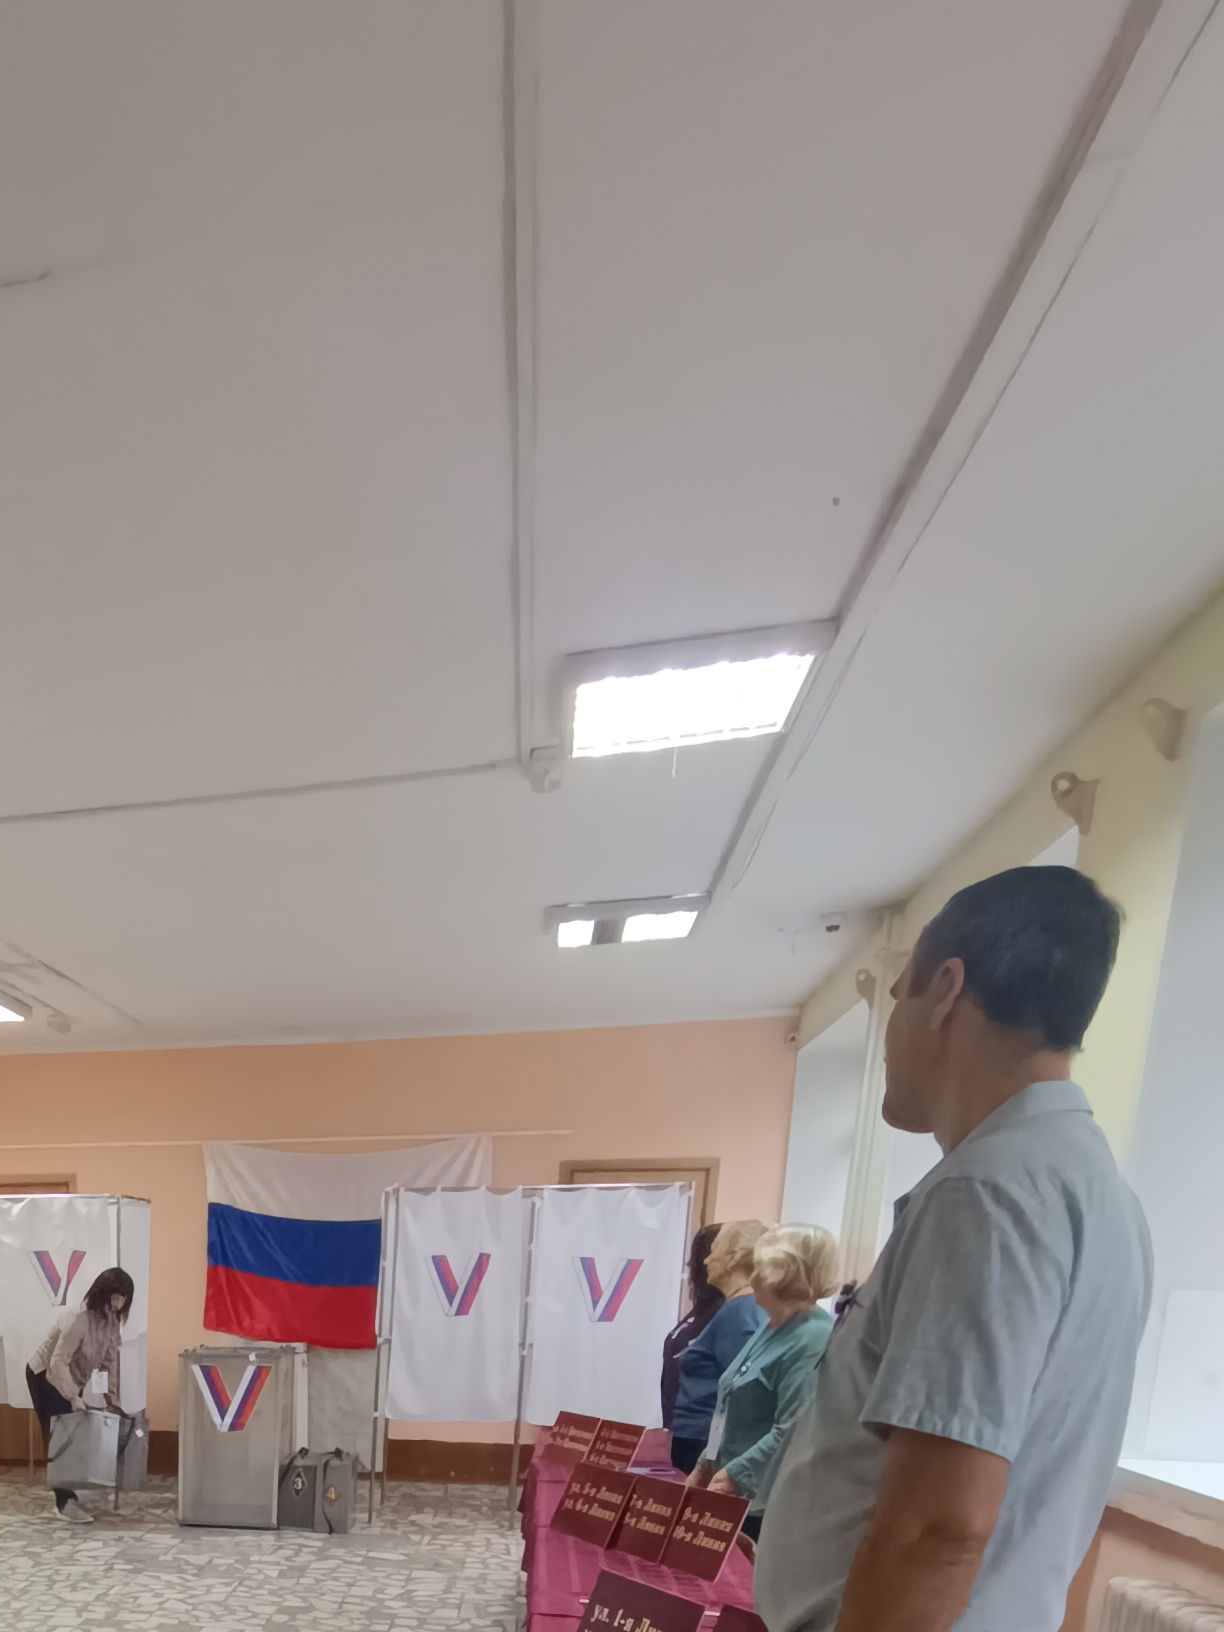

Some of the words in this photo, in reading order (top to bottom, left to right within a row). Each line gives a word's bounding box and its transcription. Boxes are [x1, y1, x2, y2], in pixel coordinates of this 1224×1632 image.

[293, 1477, 303, 1490] 3
[327, 1486, 336, 1500] 4
[698, 1511, 734, 1533] Линия
[692, 1530, 727, 1552] Линия
[613, 1608, 635, 1632] 1-я
